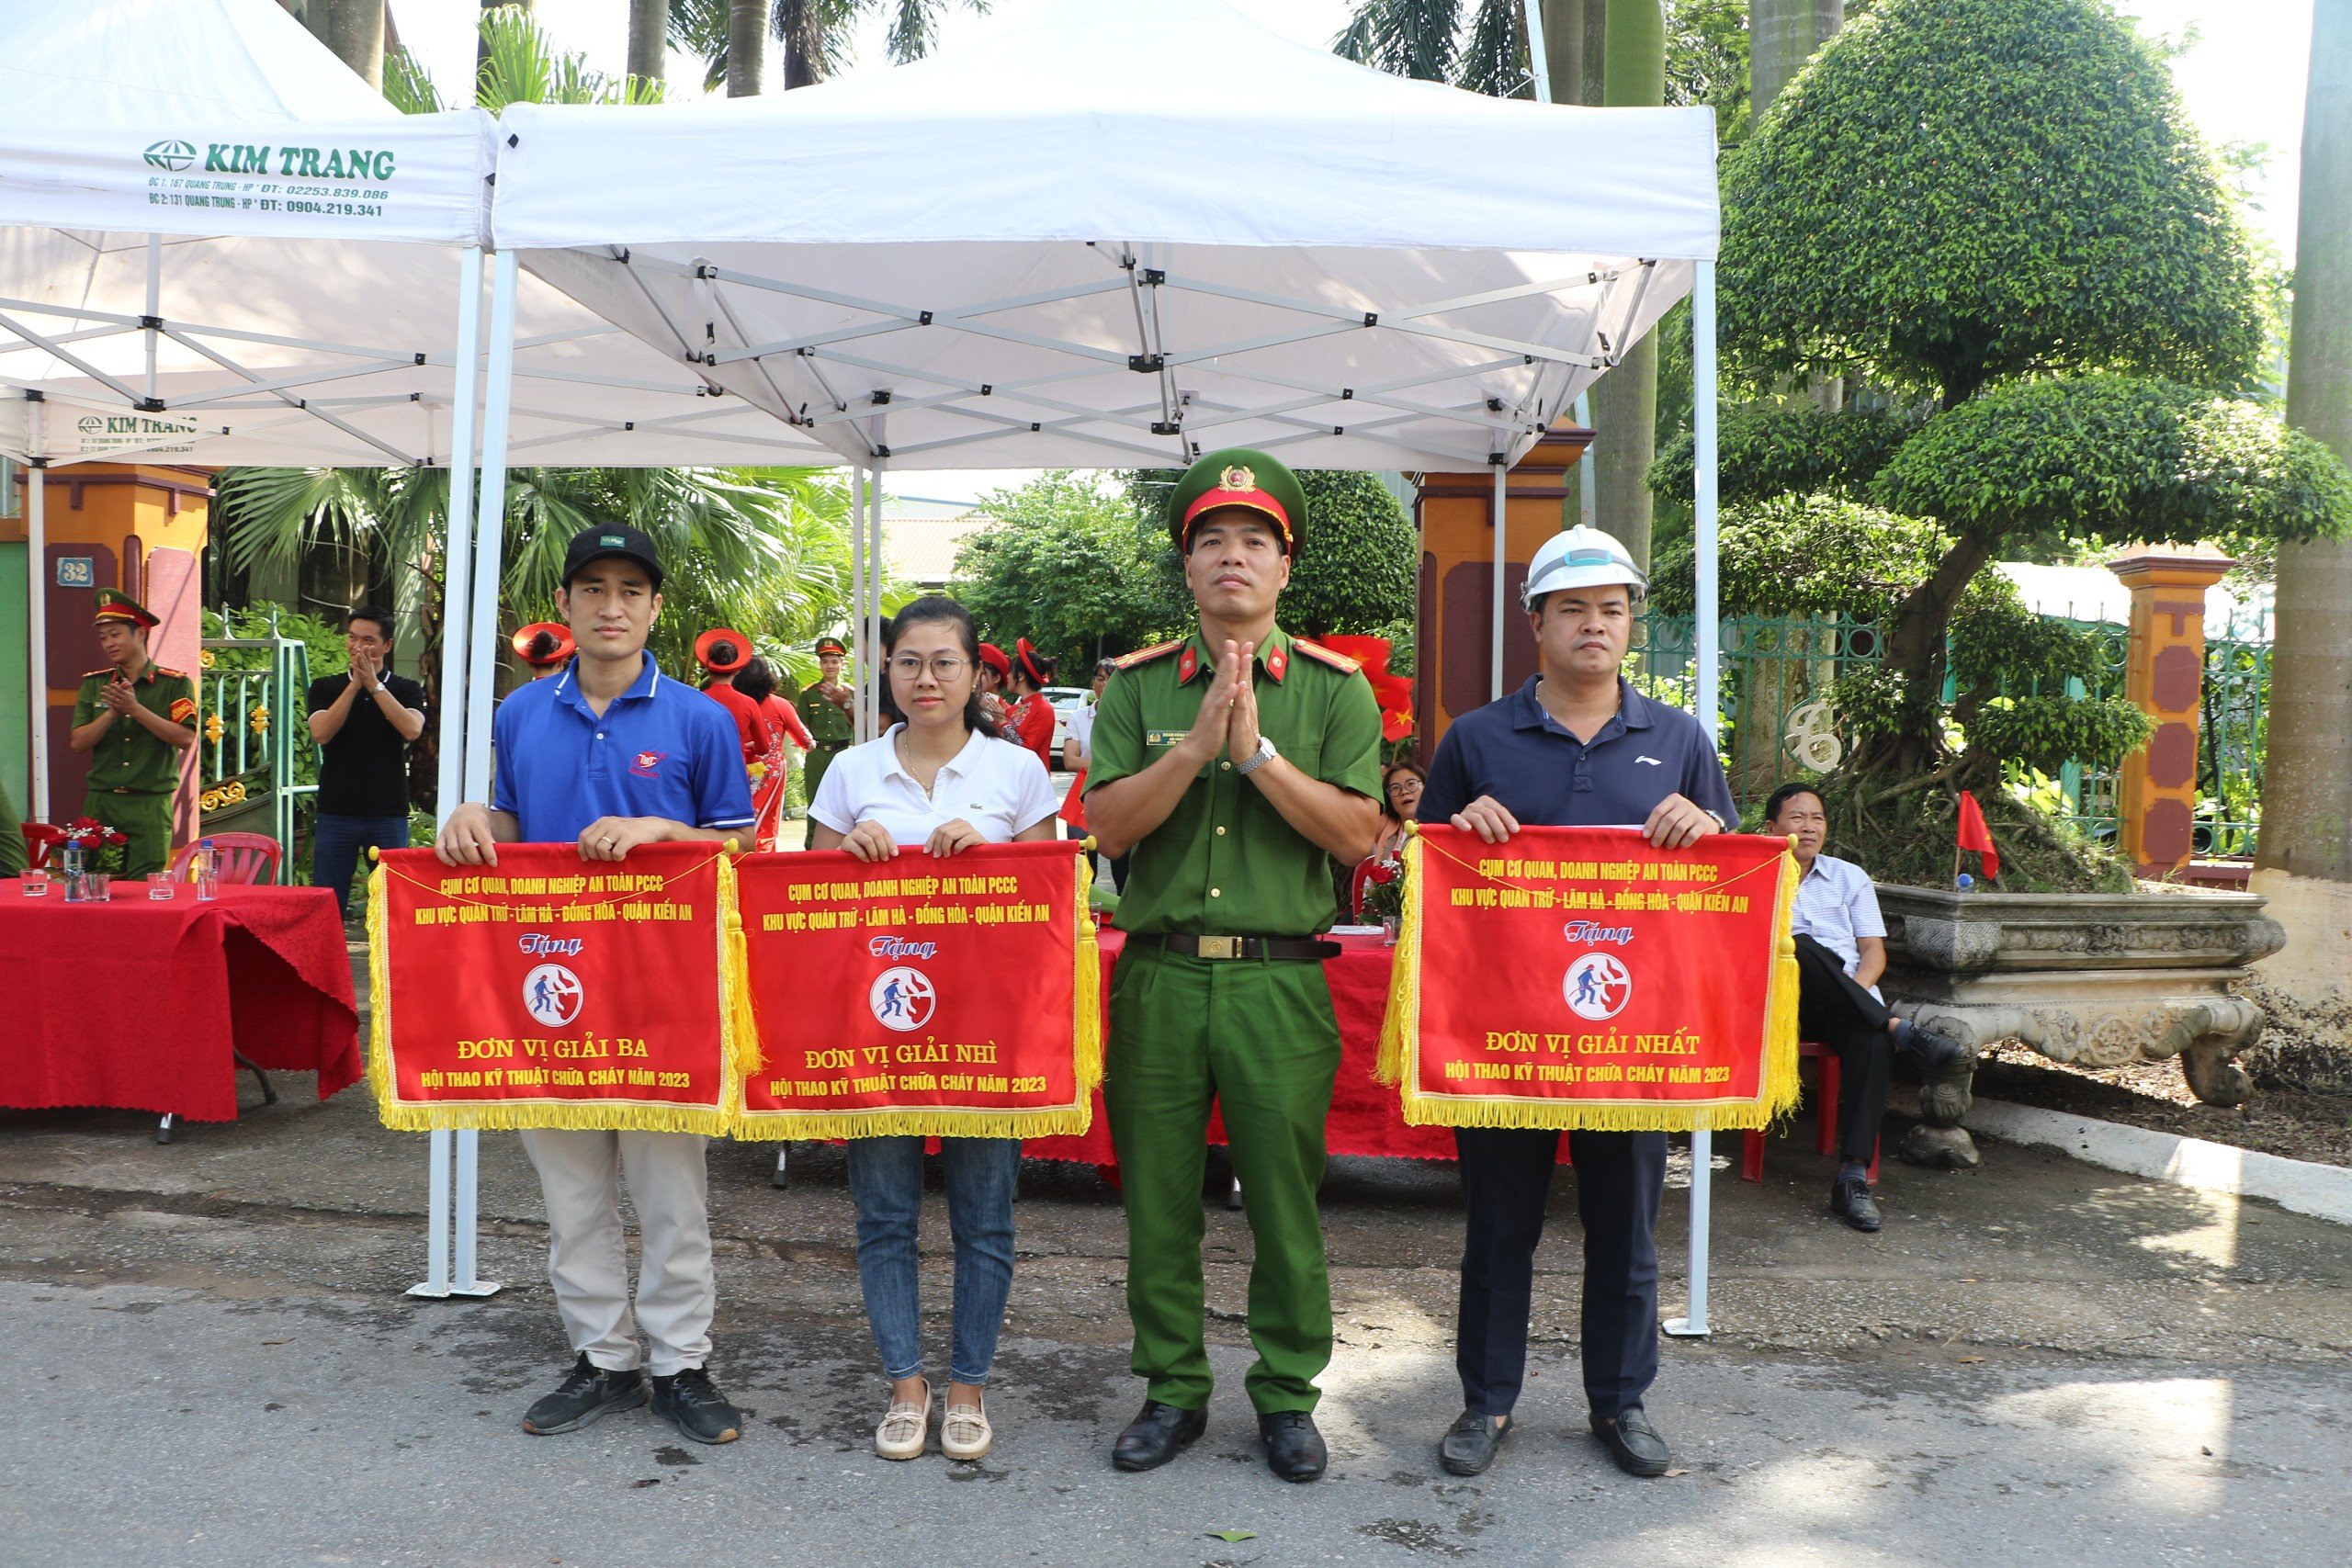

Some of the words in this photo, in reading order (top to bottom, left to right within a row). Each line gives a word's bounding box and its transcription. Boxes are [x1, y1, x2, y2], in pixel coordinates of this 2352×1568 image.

[205, 143, 271, 175] KIM
[279, 147, 396, 181] TRANG
[185, 180, 210, 189] QUANG
[211, 181, 237, 191] TRUNG
[243, 184, 254, 192] HP
[261, 184, 281, 194] ĐT:
[287, 186, 389, 200] 02253.839.086
[170, 195, 183, 206] 131
[186, 195, 209, 208] QUANG
[211, 197, 235, 209] TRUNG
[242, 198, 253, 209] HP
[259, 198, 282, 211] ĐT:
[287, 200, 382, 217] 0904.219.341
[107, 417, 137, 434] KIM
[63, 562, 88, 582] 32
[465, 877, 480, 895] CƠ
[481, 878, 510, 897] QUAN,
[510, 877, 546, 895] DOANH
[548, 874, 587, 897] NGHIỆP
[588, 875, 605, 893] AN
[606, 873, 634, 892] TOÀN
[636, 875, 663, 891] PCCC
[1507, 858, 1523, 878] CƠ
[1524, 861, 1558, 882] QUAN,
[1560, 862, 1598, 880] DOANH
[1600, 860, 1639, 885] NGHIỆP
[1642, 863, 1658, 882] AN
[1660, 860, 1688, 882] TOÀN
[1690, 863, 1718, 883] PCCC
[788, 883, 811, 905] CỤM
[814, 882, 830, 900] CƠ
[830, 882, 861, 901] QUAN,
[863, 880, 899, 898] DOANH
[900, 874, 939, 899] NGHIỆP
[942, 878, 956, 896] AN
[958, 874, 986, 895] TOÀN
[988, 875, 1017, 894] PCCC
[1451, 887, 1473, 907] KHU
[1476, 887, 1498, 910] VỰC
[1590, 888, 1605, 910] HÀ
[1731, 895, 1748, 914] AN
[415, 908, 436, 925] KHU
[437, 905, 458, 928] VỰC
[594, 901, 615, 921] HÒA
[623, 902, 651, 923] QUẬN
[653, 898, 677, 920] KIẾN
[678, 905, 693, 921] AN
[763, 913, 784, 931] KHU
[786, 911, 807, 934] VỰC
[808, 908, 836, 931] QUÁN
[838, 907, 858, 928] TRỮ
[891, 905, 907, 926] HÀ
[915, 900, 944, 925] ĐỒNG
[946, 903, 967, 924] HÒA
[975, 902, 1004, 927] QUẬN
[1006, 898, 1032, 923] KIẾN
[1034, 904, 1050, 922] AN
[518, 933, 583, 959] Tặng
[1564, 920, 1634, 947] Tặng
[869, 935, 937, 961] Tặng
[458, 1038, 514, 1059] ĐƠN
[522, 1040, 548, 1063] VỊ
[553, 1032, 608, 1058] GIẢI
[616, 1038, 649, 1057] BA
[804, 1046, 854, 1069] ĐƠN
[861, 1046, 890, 1068] VỊ
[896, 1035, 949, 1064] GIẢI
[955, 1040, 998, 1064] NHÌ
[1486, 1030, 1538, 1053] ĐƠN
[1544, 1033, 1573, 1059] VỊ
[1577, 1026, 1628, 1055] GIẢI
[1634, 1026, 1701, 1055] NHẤT
[421, 1068, 444, 1090] HỘI
[446, 1071, 480, 1088] THAO
[484, 1066, 503, 1087] KỸ
[506, 1066, 549, 1089] THUẬT
[552, 1066, 585, 1087] CHỮA
[588, 1066, 625, 1087] CHÁY
[628, 1067, 655, 1087] NĂM
[659, 1071, 690, 1089] 2023
[770, 1077, 792, 1100] HỘI
[794, 1079, 827, 1096] THAO
[831, 1075, 849, 1095] KỸ
[852, 1074, 896, 1095] THUẬT
[899, 1071, 937, 1091] CHỮA
[941, 1072, 974, 1092] CHÁY
[978, 1072, 1008, 1093] NĂM
[1011, 1076, 1046, 1093] 2023
[1445, 1058, 1469, 1083] HỘI
[1473, 1062, 1510, 1080] THAO
[1513, 1060, 1533, 1080] KỸ
[1537, 1061, 1582, 1086] THUẬT
[1586, 1062, 1623, 1083] CHỮA
[1626, 1062, 1664, 1083] CHÁY
[1668, 1064, 1701, 1084] NĂM
[1703, 1066, 1730, 1084] 2023
